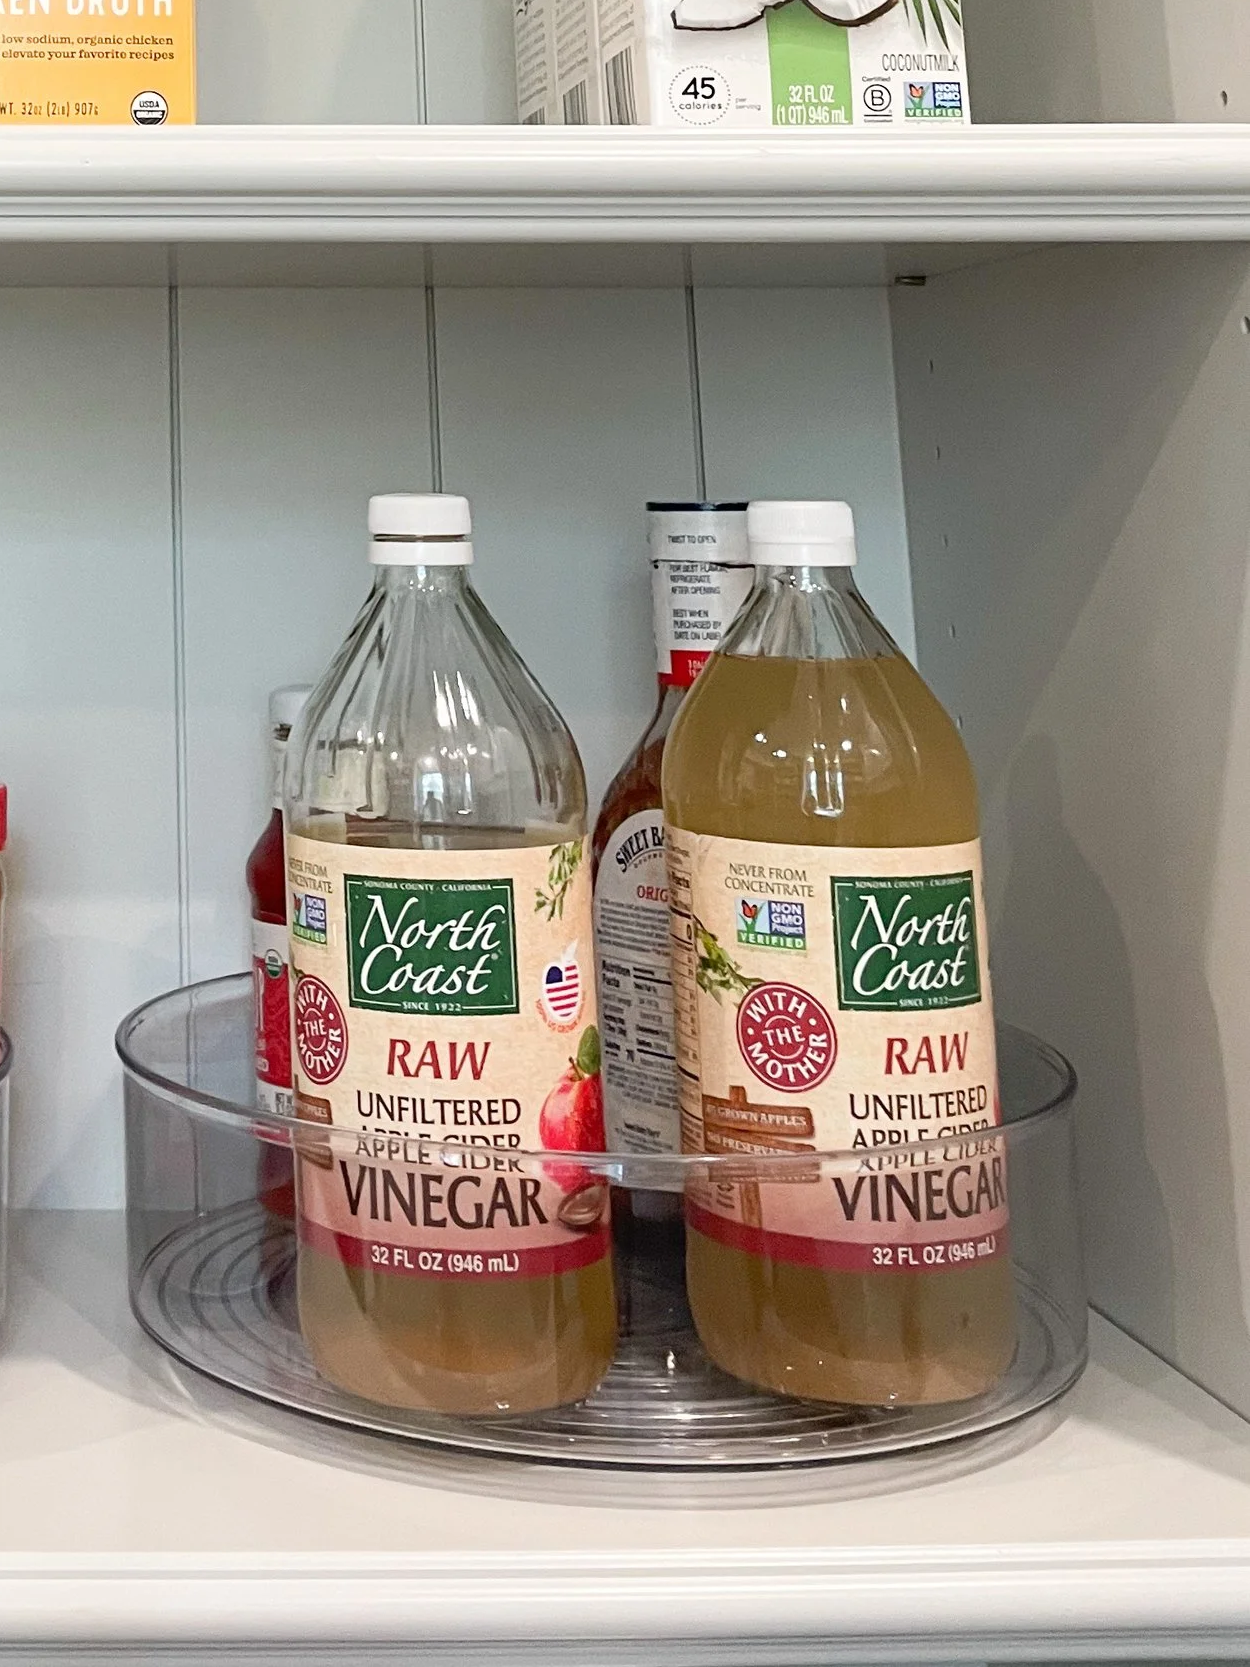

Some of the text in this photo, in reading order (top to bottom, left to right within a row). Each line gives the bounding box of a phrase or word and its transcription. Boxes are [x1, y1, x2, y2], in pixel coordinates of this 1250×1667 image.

[2, 34, 24, 45] low
[26, 34, 74, 45] sodium,
[76, 35, 123, 48] organic
[125, 34, 174, 46] chicken
[1, 49, 46, 59] elevate
[47, 50, 77, 61] your
[78, 48, 127, 59] favorite
[129, 49, 175, 61] recipes
[881, 54, 960, 72] COCONUTMILK
[681, 77, 716, 100] 45
[788, 85, 835, 103] 32 FL OZ
[935, 83, 959, 92] NON
[935, 92, 960, 100] GMO
[0, 102, 17, 115] WT.
[679, 102, 722, 110] calories
[776, 104, 849, 124] (1 QT) 946 mL
[907, 109, 962, 117] VERIFIED
[616, 829, 650, 873] SWEET
[305, 862, 327, 878] FROM
[730, 862, 807, 882] NEVER FROM
[363, 880, 492, 892] SONOMA COUNTY CALIFORNIA
[724, 877, 815, 898] CONCENTRATE
[855, 880, 892, 889] SONOMA
[306, 896, 325, 910] NON
[771, 903, 802, 915] NON
[359, 895, 505, 951] North
[771, 913, 803, 925] GMO
[851, 894, 971, 950] North
[740, 931, 804, 948] VERIFIED
[360, 943, 492, 995] Coast
[852, 943, 967, 996] Coast
[298, 984, 329, 1014] WITH
[402, 1001, 462, 1011] SINCE 1922
[746, 991, 808, 1023] WITH
[303, 1018, 327, 1038] THE
[761, 1025, 806, 1046] THE
[297, 1027, 342, 1075] MOTHER
[387, 1038, 492, 1081] RAW
[747, 1032, 828, 1083] MOTHER
[883, 1032, 969, 1076] RAW
[356, 1089, 522, 1126] UNFILTERED
[848, 1084, 988, 1122] UNFILTERED
[717, 1107, 807, 1127] GROWN APPLES
[355, 1125, 526, 1174] APPLE CIDER
[851, 1118, 999, 1174] APPLE CIDER
[339, 1159, 549, 1230] VINEGAR
[831, 1156, 1006, 1223] VINEGAR
[371, 1245, 519, 1273] 32 FL OZ (946 mL)
[872, 1235, 997, 1266] 32 FL OZ (946 mL)
